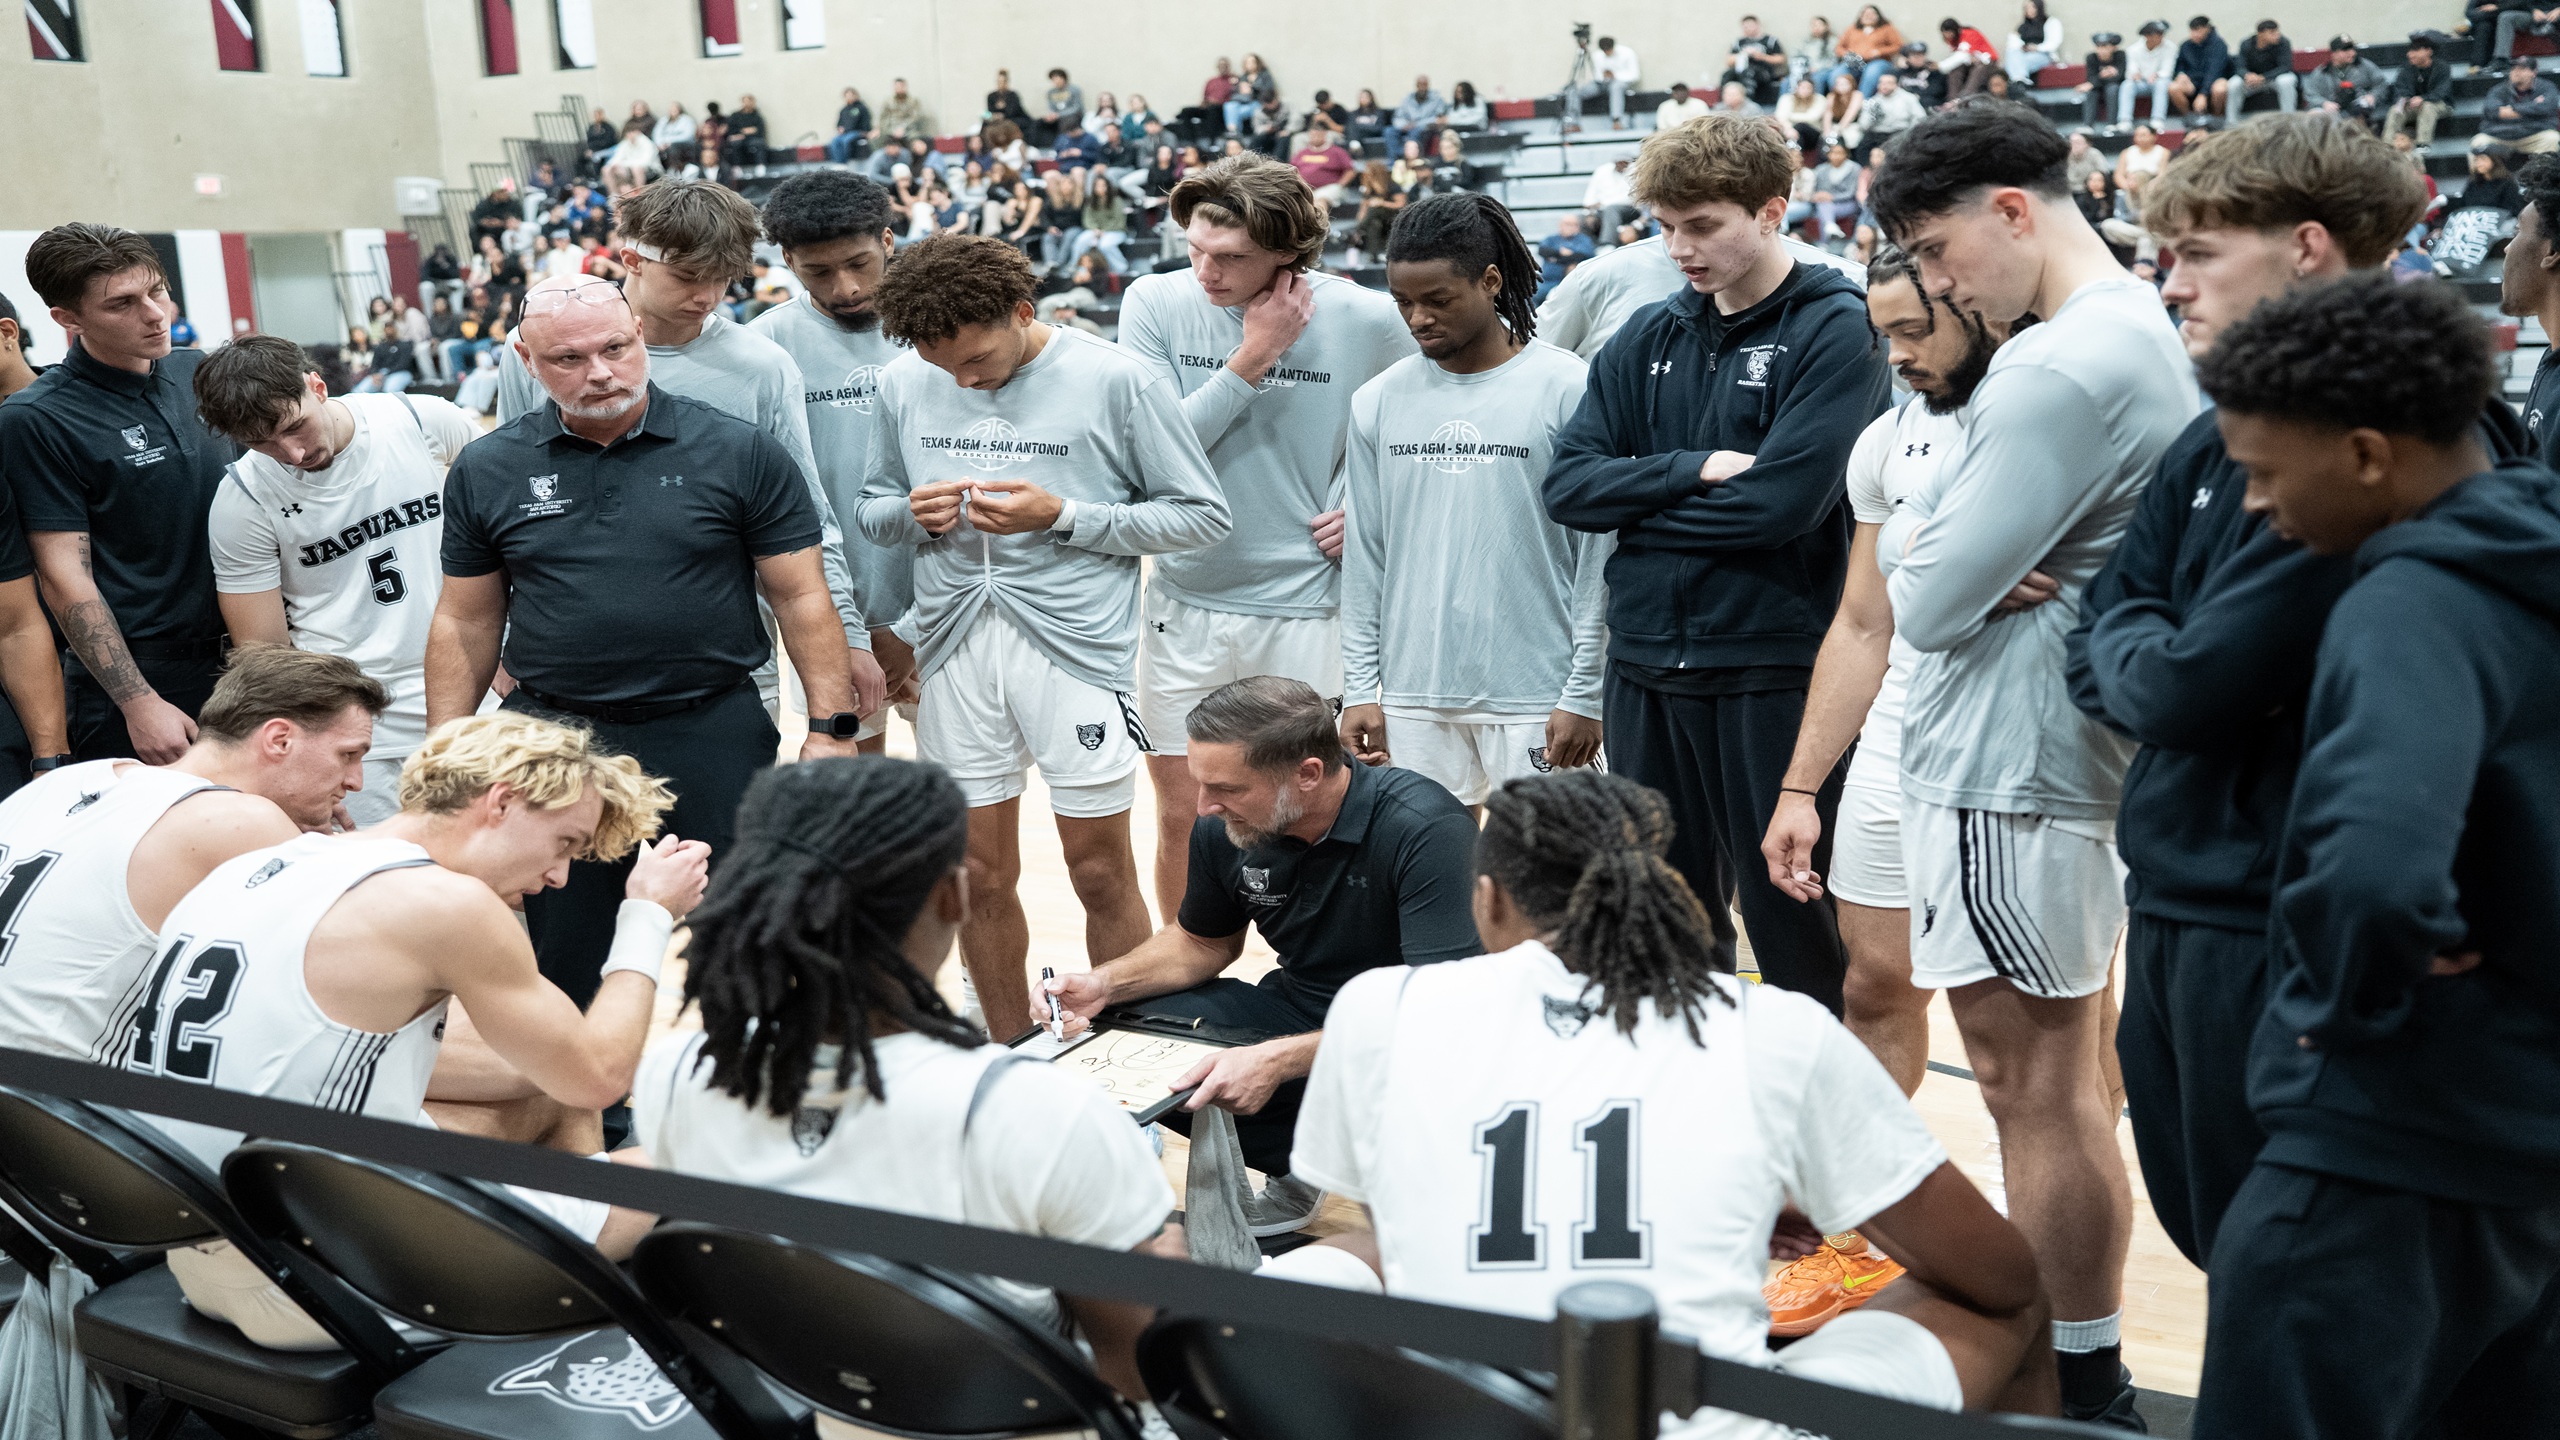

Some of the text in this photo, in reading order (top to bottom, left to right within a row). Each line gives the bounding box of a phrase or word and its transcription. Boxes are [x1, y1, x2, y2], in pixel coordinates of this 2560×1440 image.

[1180, 354, 1214, 369] TEXAS
[1279, 368, 1331, 384] ANTONIO
[805, 390, 833, 404] EXAS
[836, 387, 862, 399] A&M
[921, 436, 951, 449] TEXAS
[954, 438, 980, 450] A&M
[990, 440, 1013, 453] SAN
[1015, 442, 1069, 457] ANTONIO
[955, 451, 1023, 461] BASKETBALL
[1389, 443, 1418, 456] TEXAS
[1420, 443, 1445, 454] A&M
[1455, 443, 1476, 454] SAN
[1478, 443, 1529, 459] ANTONIO
[298, 491, 443, 568] JAGUARS
[365, 546, 409, 607] 5
[0, 843, 63, 967] 1
[126, 933, 248, 1086] 42
[1467, 1099, 1653, 1272] 11
